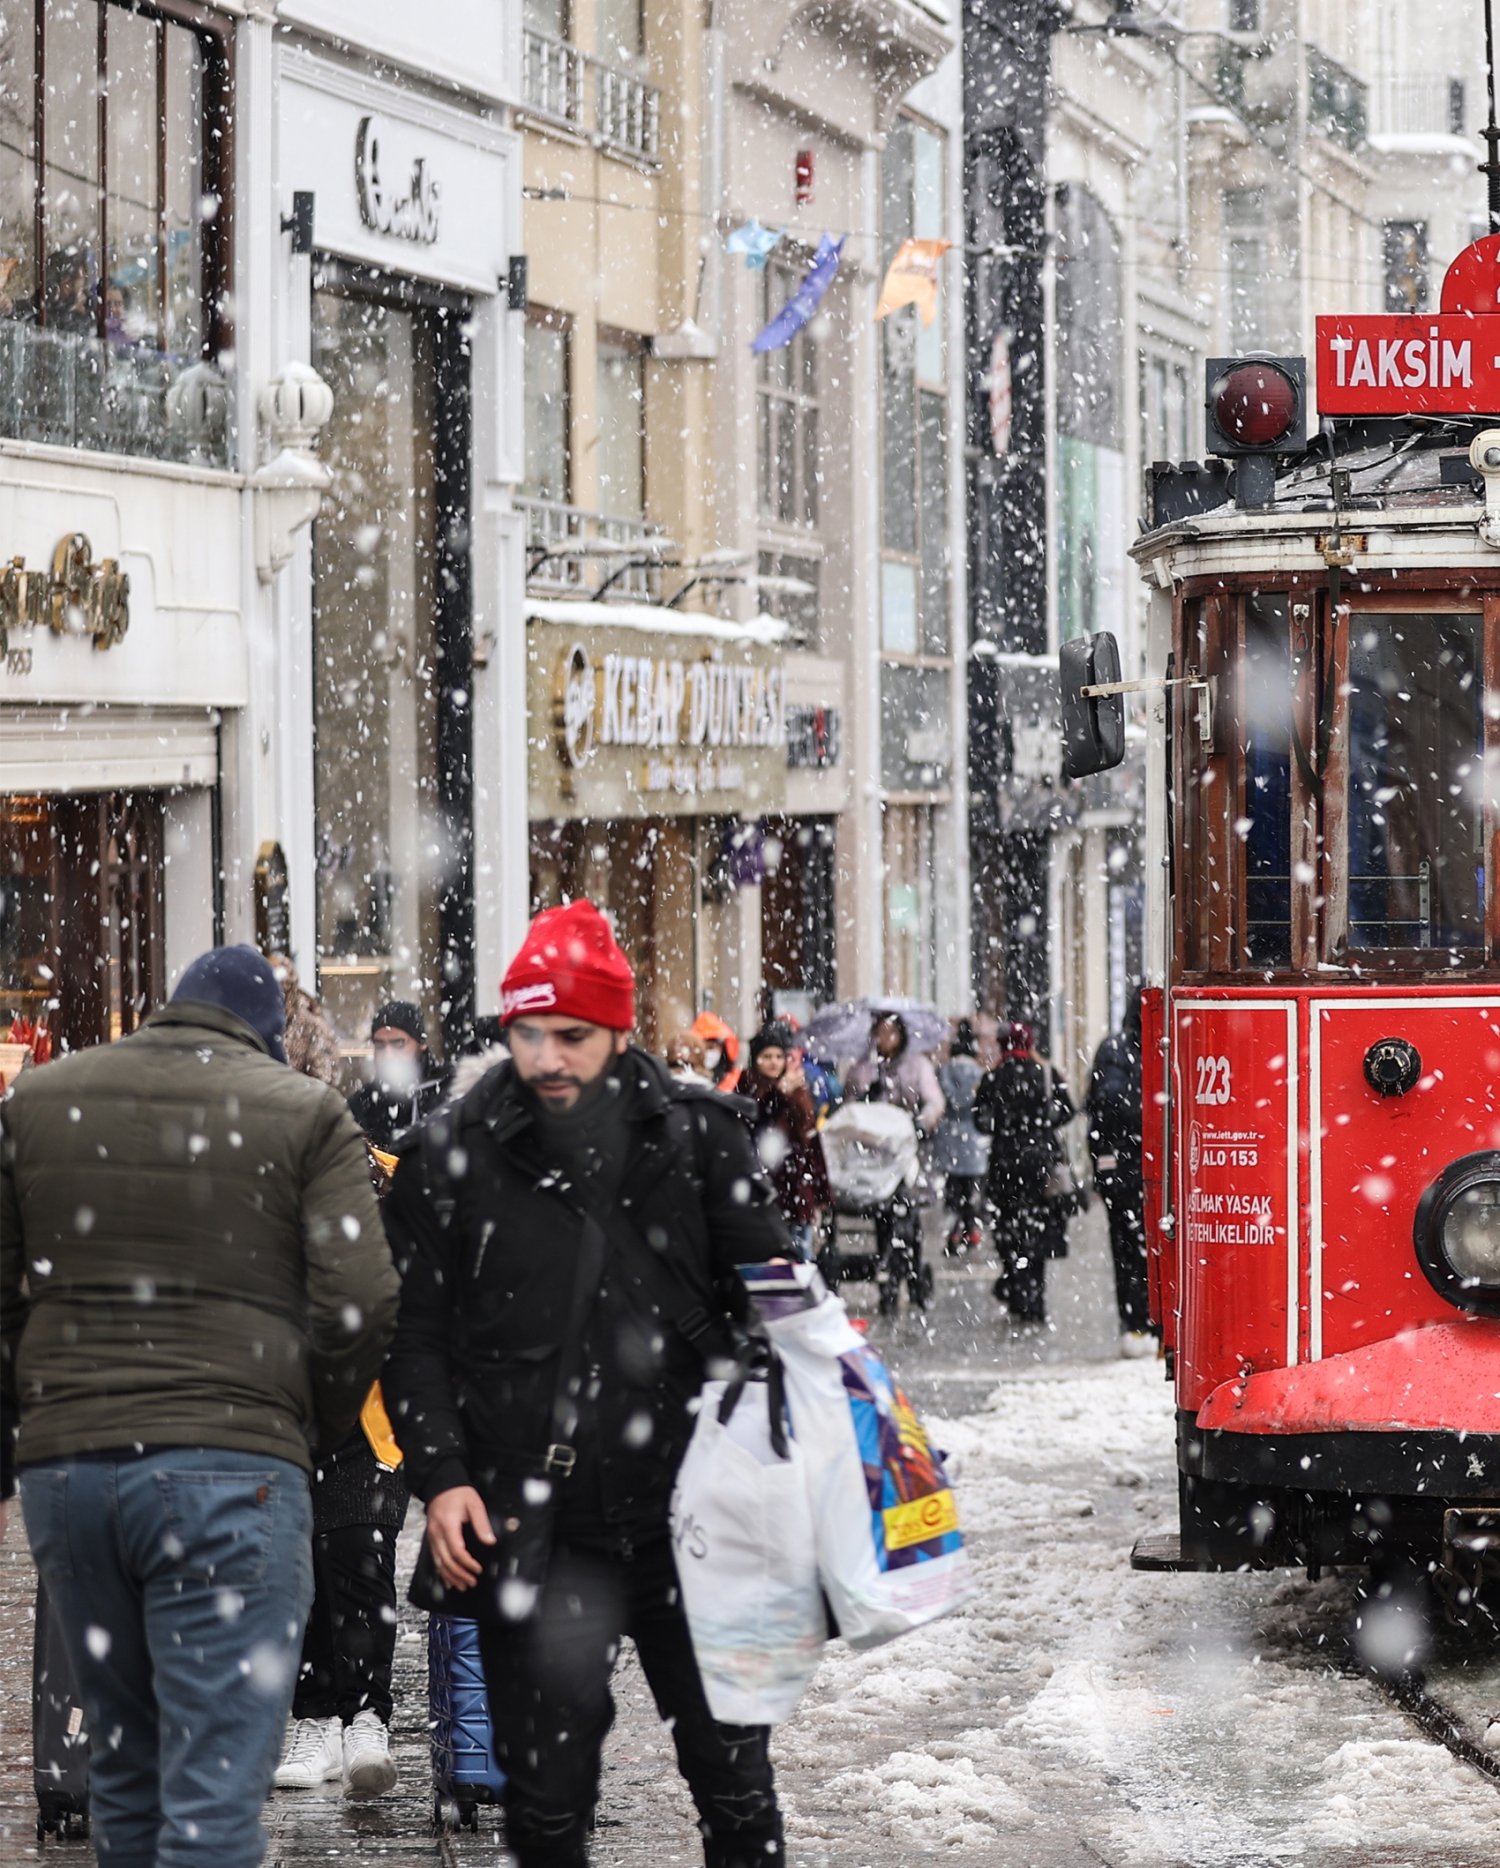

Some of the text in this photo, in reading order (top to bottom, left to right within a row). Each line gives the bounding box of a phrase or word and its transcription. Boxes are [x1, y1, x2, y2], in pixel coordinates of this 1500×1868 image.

[1330, 326, 1471, 388] TAKSİM
[602, 655, 686, 746] KEBAP
[1196, 1055, 1231, 1105] 223
[1201, 1150, 1227, 1166] ALO
[1230, 1150, 1258, 1166] 153
[1225, 1195, 1272, 1215] YASAK
